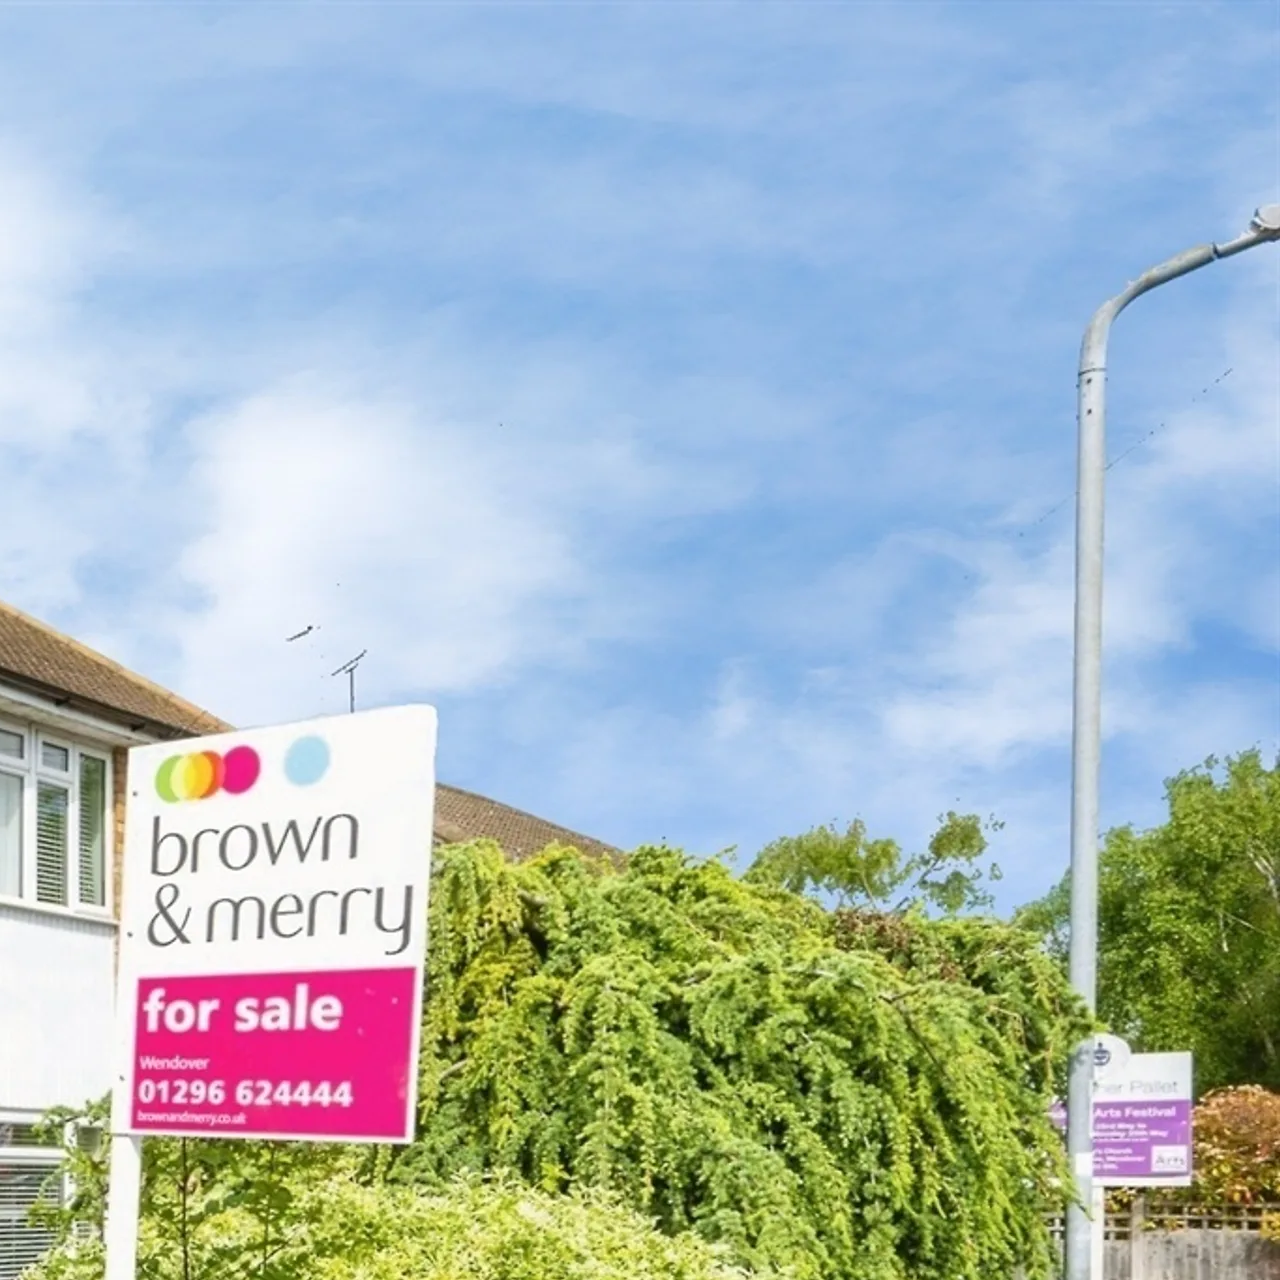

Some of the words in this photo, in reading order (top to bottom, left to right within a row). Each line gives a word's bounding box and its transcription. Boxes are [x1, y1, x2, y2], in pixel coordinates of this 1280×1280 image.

[150, 812, 360, 877] brown
[147, 883, 192, 947] &
[206, 885, 414, 955] merry
[143, 988, 220, 1033] for
[234, 983, 344, 1032] sale
[139, 1055, 210, 1071] Wendover
[138, 1079, 226, 1104] 01296
[235, 1080, 354, 1107] 624444
[137, 1110, 247, 1125] brownandmerry.co.uk
[1094, 1107, 1122, 1118] Arts
[1124, 1106, 1177, 1117] Festival
